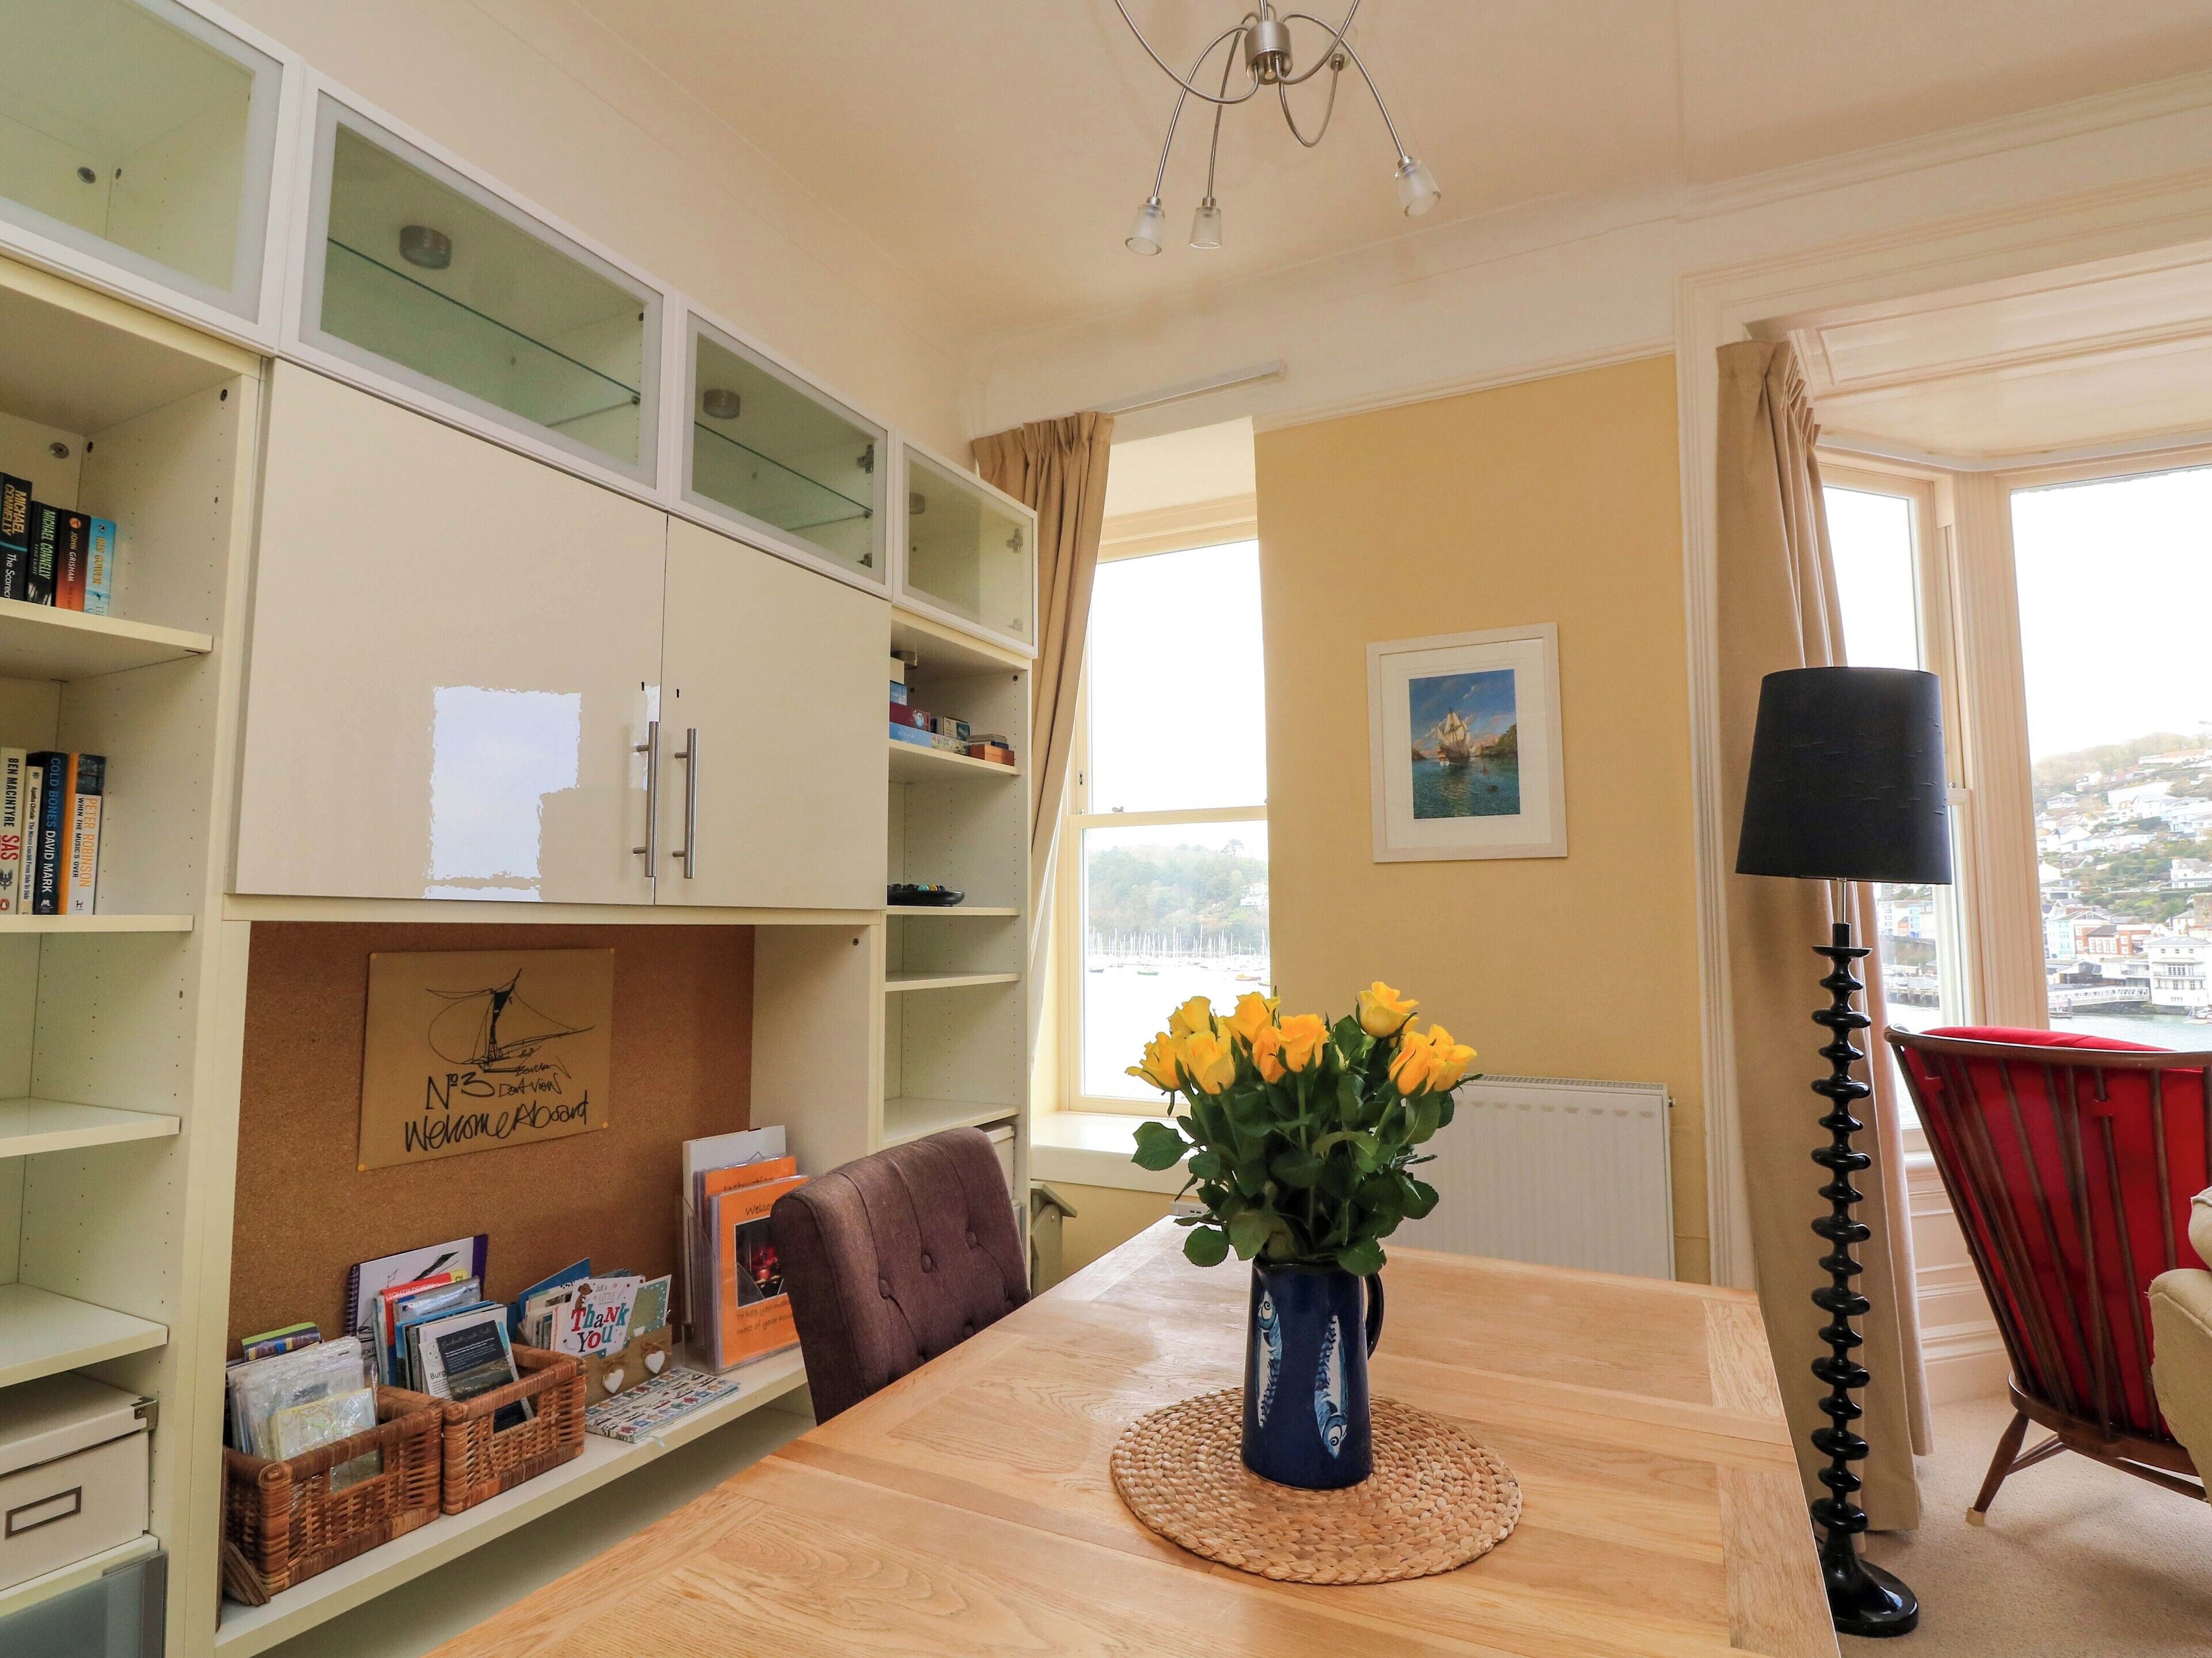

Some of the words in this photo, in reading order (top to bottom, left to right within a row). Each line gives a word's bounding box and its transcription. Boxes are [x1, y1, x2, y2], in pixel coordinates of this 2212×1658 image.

[2, 484, 14, 536] CONNELLY
[12, 490, 26, 533] MICHAEL
[41, 509, 55, 540] MICHAEL
[69, 532, 78, 550] JOHN
[6, 553, 17, 568] The
[38, 542, 52, 579] CONNELLY
[67, 552, 77, 582] GRISHAM
[7, 758, 19, 775] BEN
[50, 758, 60, 787] COLD
[4, 777, 18, 828] MACINTYRE
[29, 803, 37, 819] Christie
[47, 791, 58, 828] BONES
[84, 798, 98, 829] PETER
[1, 834, 20, 860] SAS
[43, 830, 55, 860] DAVID
[74, 833, 82, 859] MUSIC'S
[79, 834, 95, 887] ROBINSON
[41, 863, 53, 893] MARK
[404, 1112, 509, 1152] Welcome
[511, 1090, 589, 1132] Aboard
[745, 1202, 772, 1216] Welco
